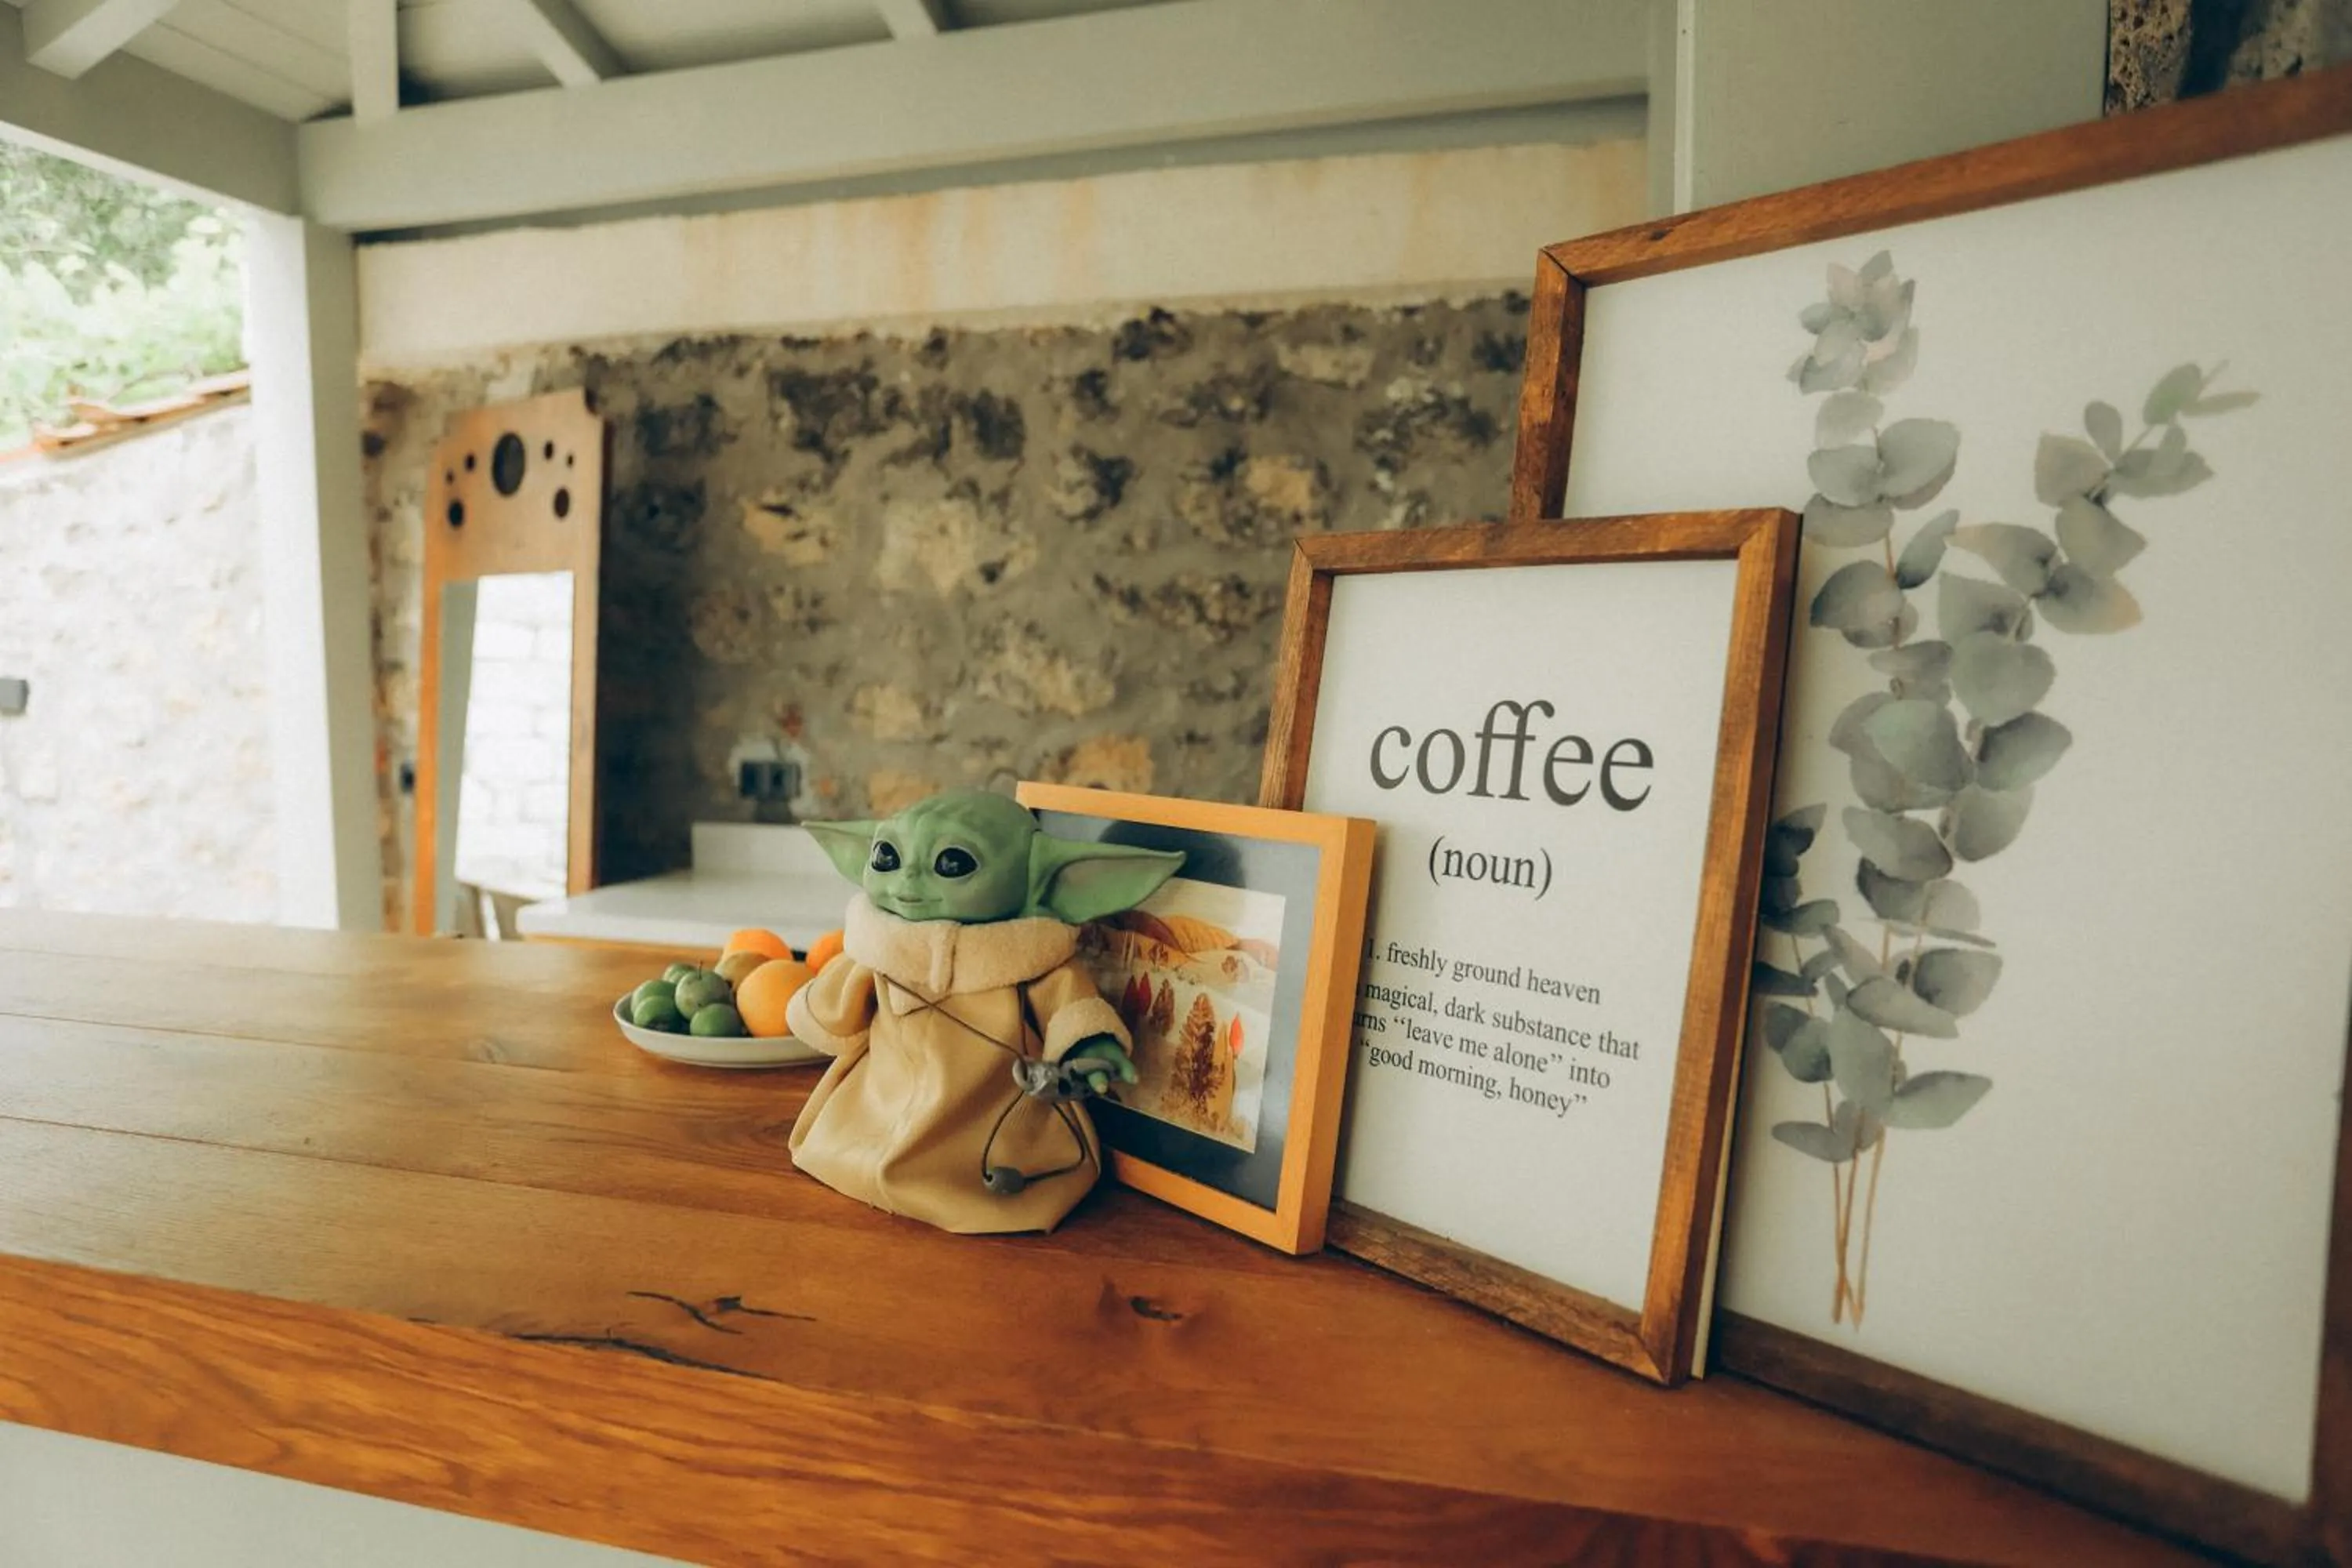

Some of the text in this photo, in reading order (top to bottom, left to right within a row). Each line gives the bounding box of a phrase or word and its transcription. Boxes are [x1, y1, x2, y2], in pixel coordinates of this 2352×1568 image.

[1370, 699, 1654, 811] coffee
[1429, 836, 1553, 901] (noun)
[1367, 938, 1601, 1004] 1. freshly ground heaven
[1366, 983, 1640, 1061] magical, dark substance that
[1417, 1057, 1503, 1099] morning,
[1458, 1036, 1488, 1058] me
[1569, 1057, 1611, 1089] into
